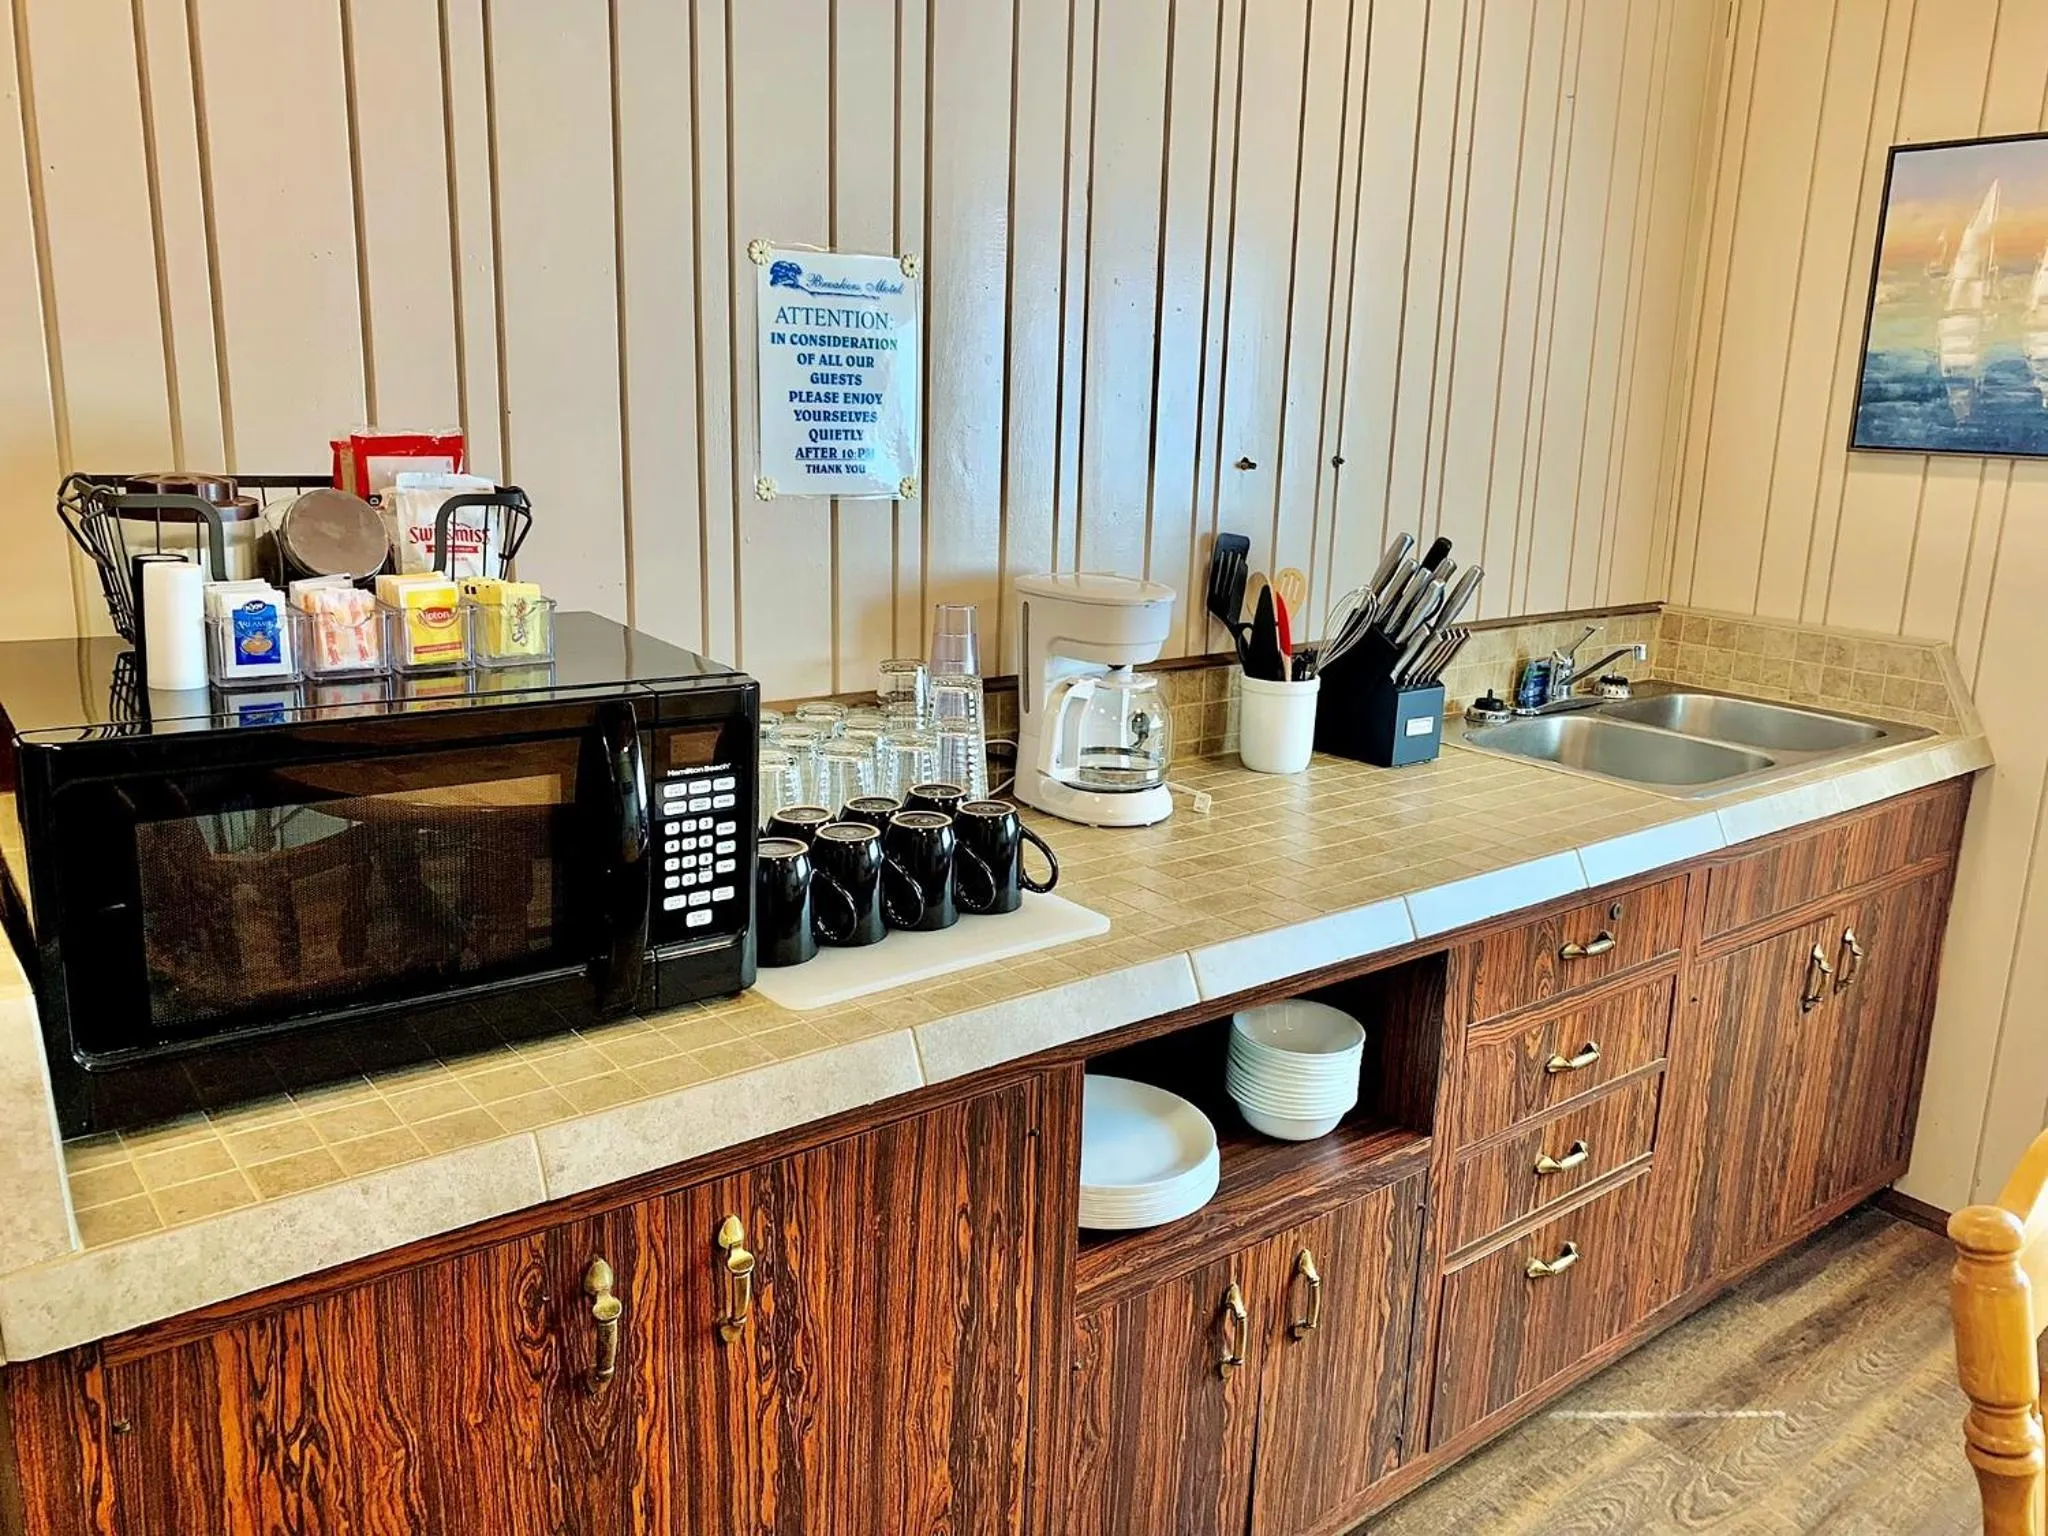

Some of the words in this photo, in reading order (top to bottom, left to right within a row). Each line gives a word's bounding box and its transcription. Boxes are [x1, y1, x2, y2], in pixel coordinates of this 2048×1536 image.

[865, 278, 904, 294] Motel
[775, 305, 894, 331] ATTENTION:
[770, 332, 786, 345] IN
[789, 333, 898, 350] CONSIDERATION
[796, 353, 815, 365] OF
[818, 354, 843, 367] ALL
[845, 355, 875, 368] OUR
[810, 372, 863, 386] GUESTS
[788, 390, 840, 404] PLEASE
[843, 392, 883, 405] ENJOY
[793, 409, 879, 423] YOURSELVES
[808, 428, 864, 443] QUIETLY
[795, 447, 838, 459] AFTER
[805, 463, 842, 474] THANK
[844, 464, 867, 474] YOU
[424, 611, 450, 620] ipton
[667, 767, 704, 777] Hamilton
[704, 763, 729, 772] Beach
